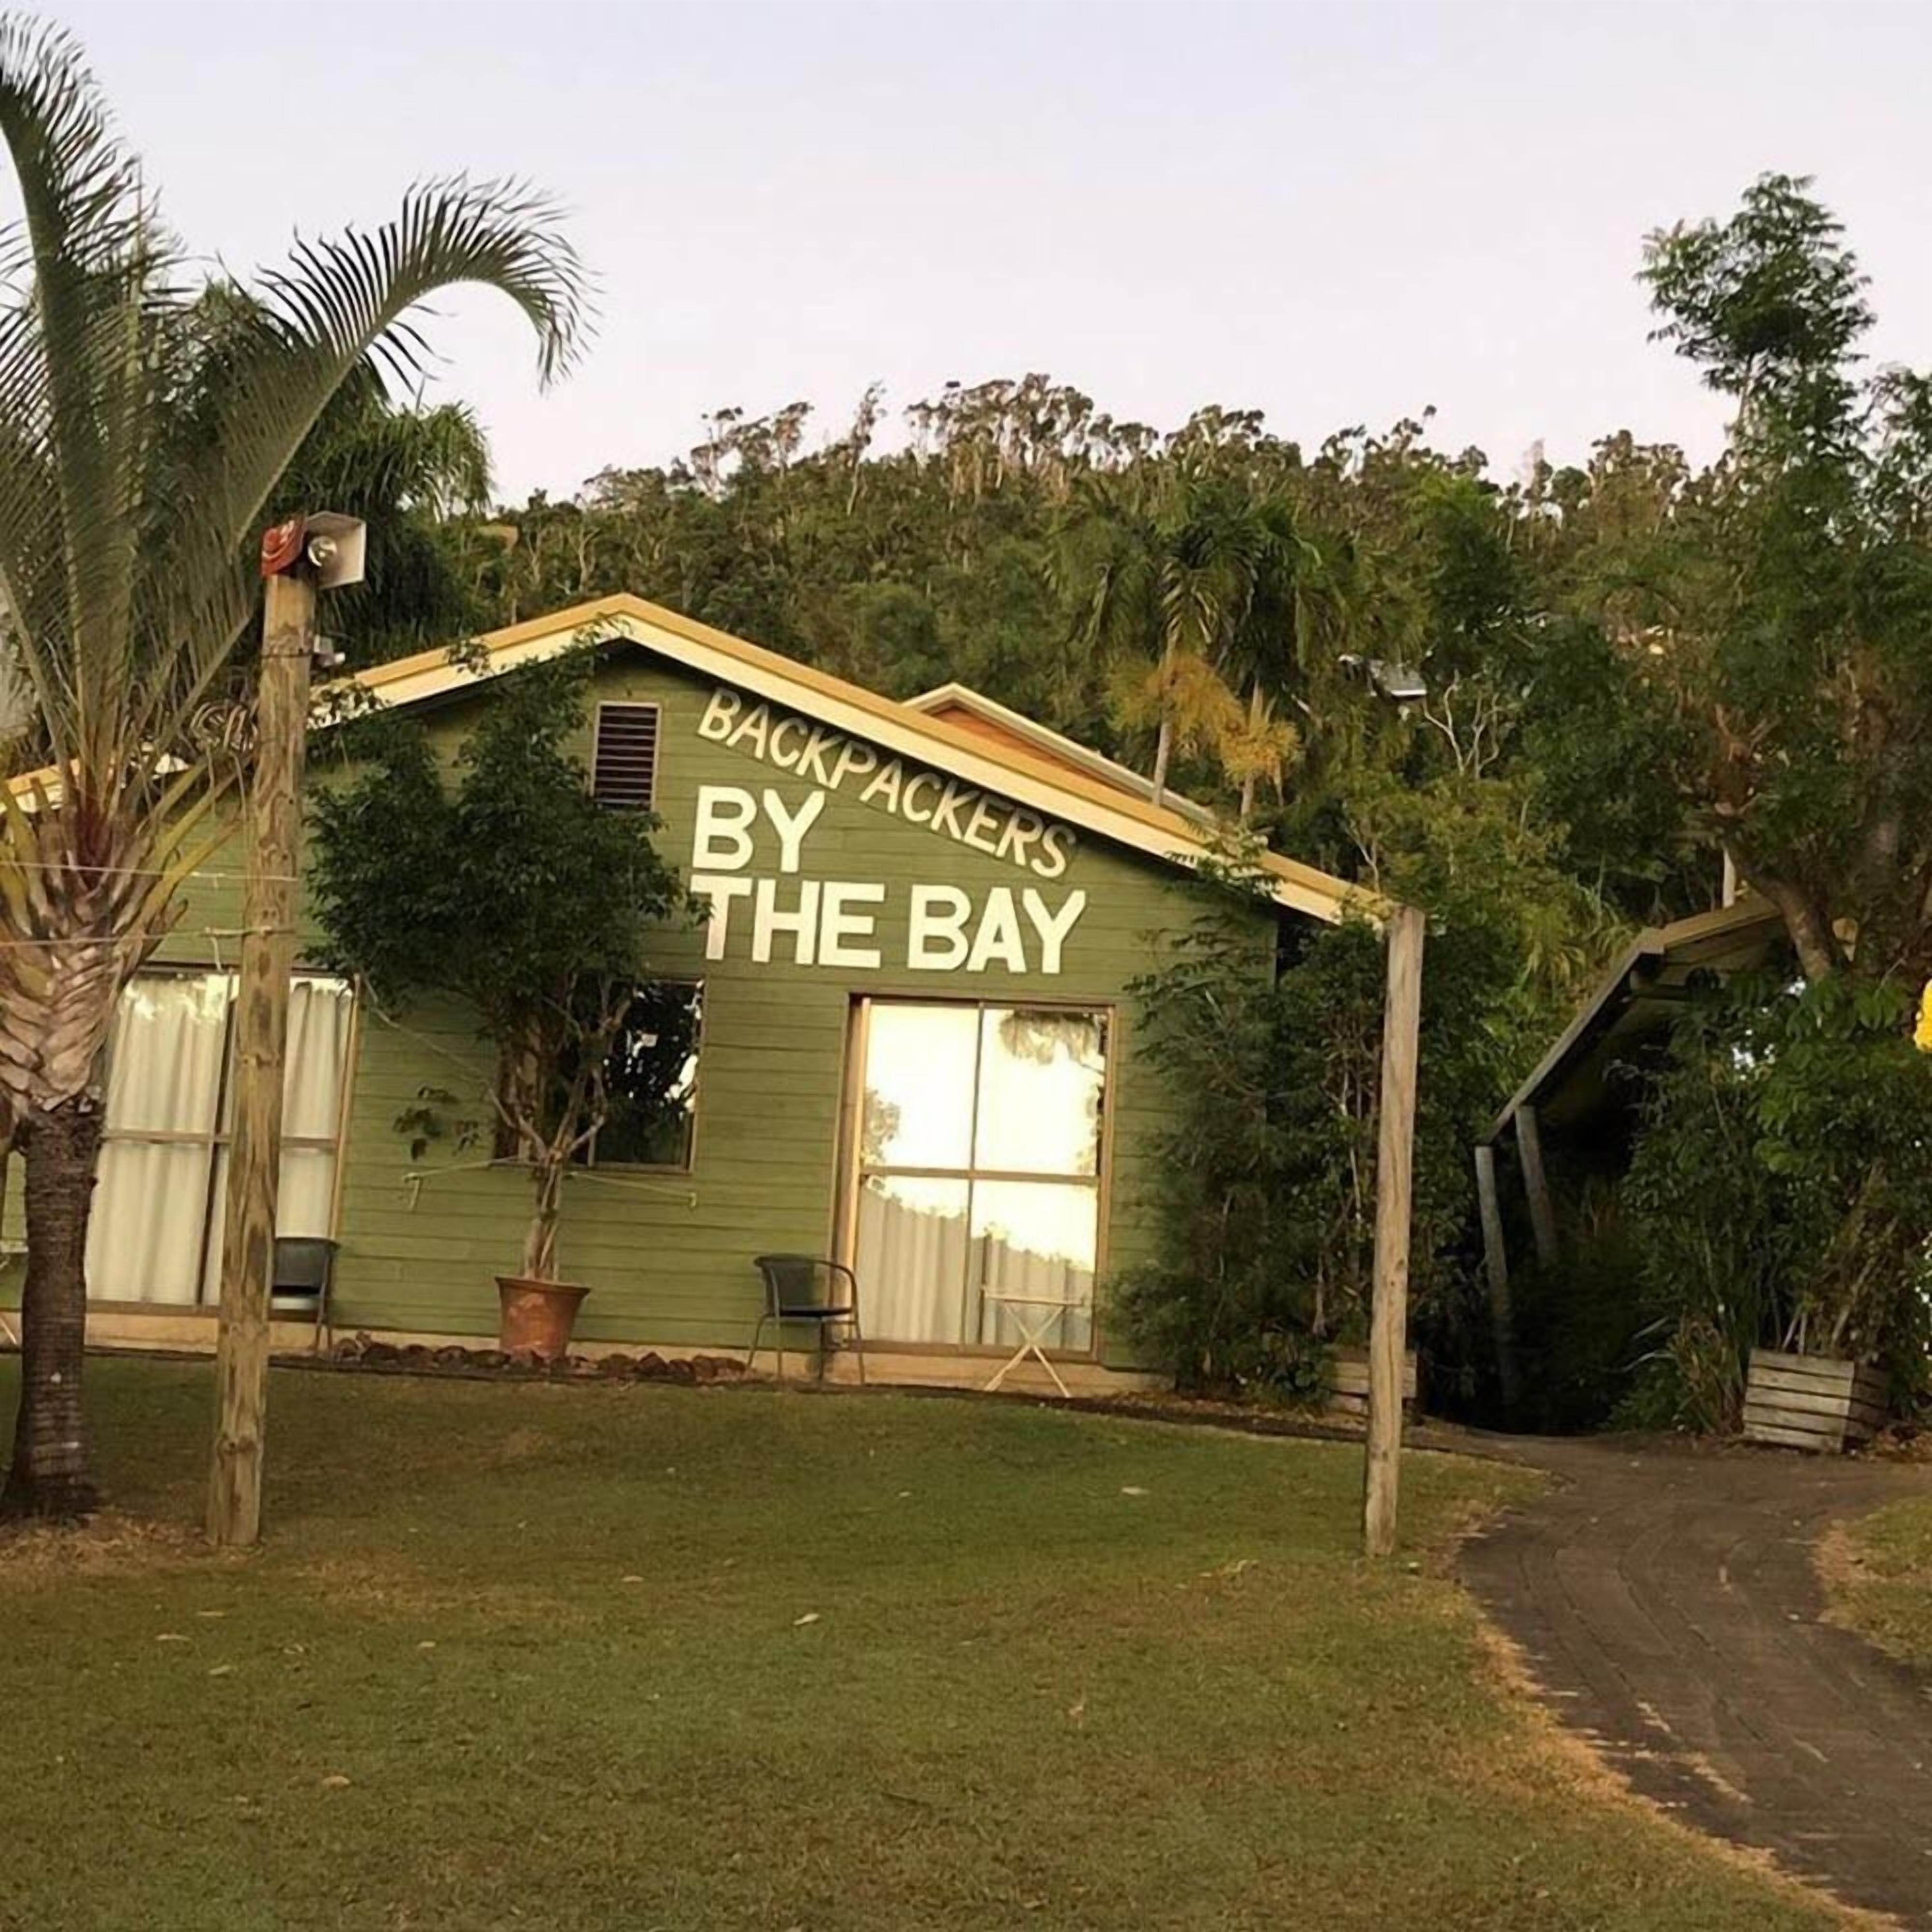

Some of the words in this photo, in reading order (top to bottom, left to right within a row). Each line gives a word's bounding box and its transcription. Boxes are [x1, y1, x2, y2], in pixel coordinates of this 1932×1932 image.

[693, 785, 825, 873] BY
[698, 688, 1076, 878] BACKPACKERS
[690, 875, 885, 968] THE
[908, 884, 1086, 974] BAY
